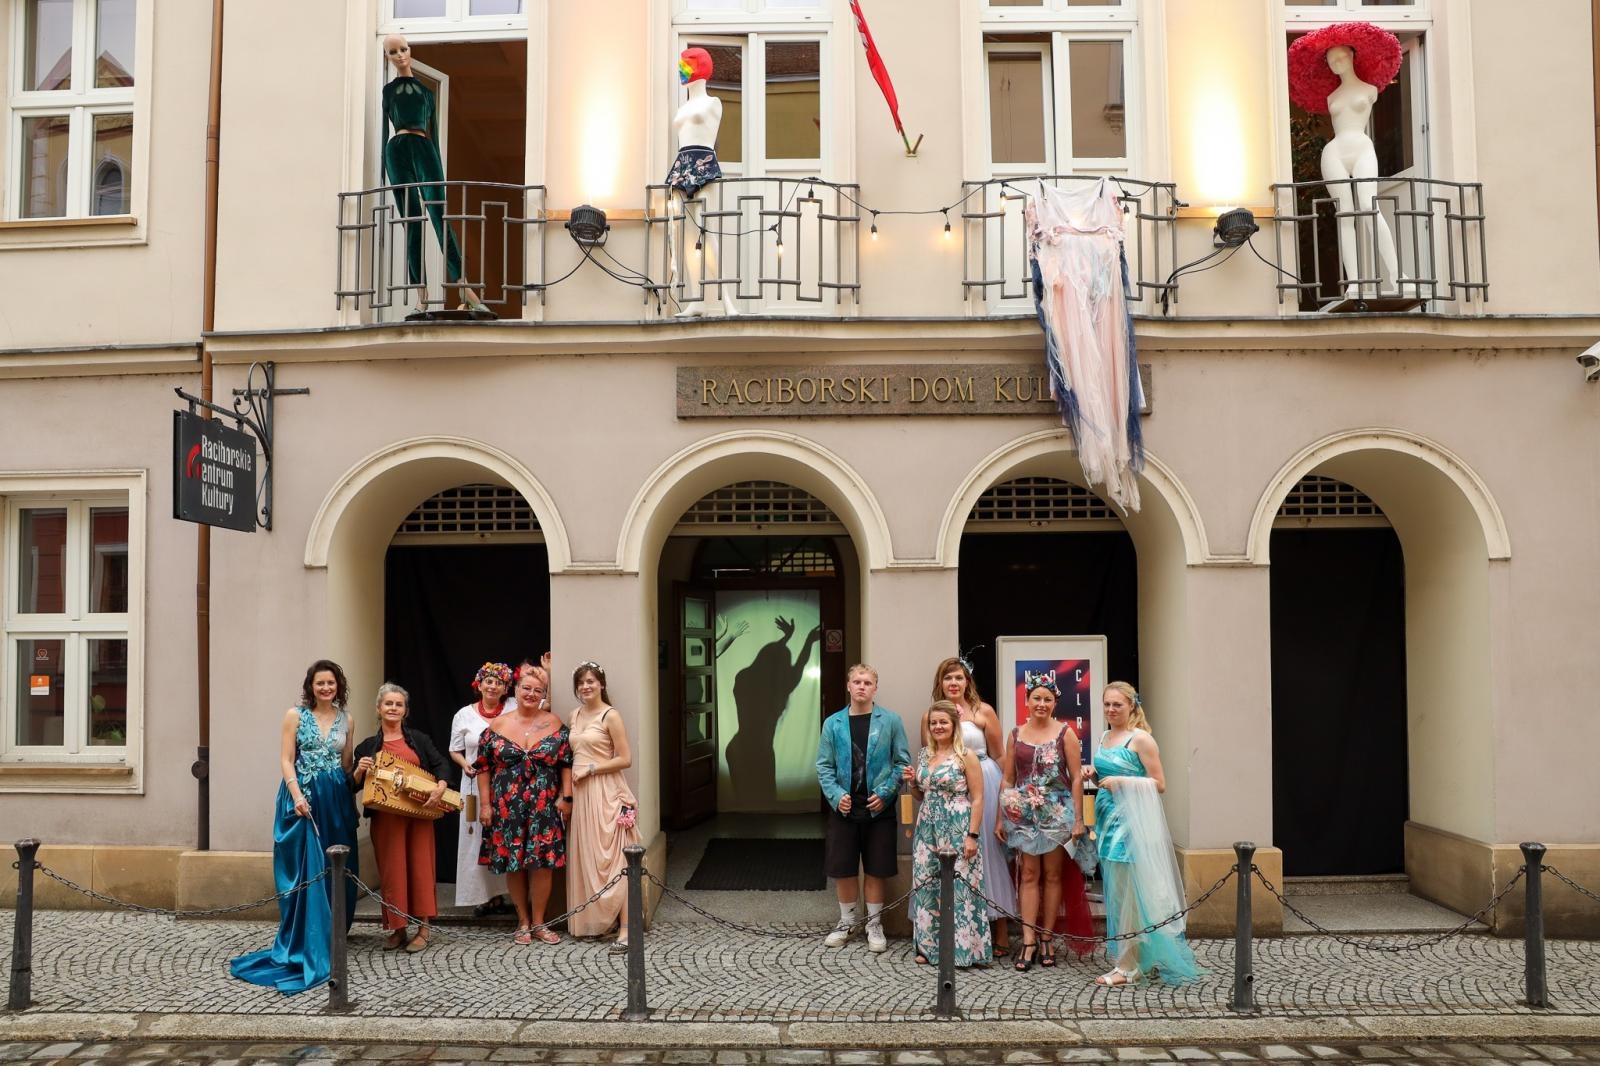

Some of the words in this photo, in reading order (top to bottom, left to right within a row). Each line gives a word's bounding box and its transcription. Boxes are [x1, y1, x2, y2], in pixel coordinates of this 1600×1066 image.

[701, 376, 891, 405] RACIBORSKI
[910, 376, 975, 404] DOM
[994, 376, 1056, 402] KUL
[201, 434, 252, 472] Raciborskie
[201, 482, 234, 515] Kultury
